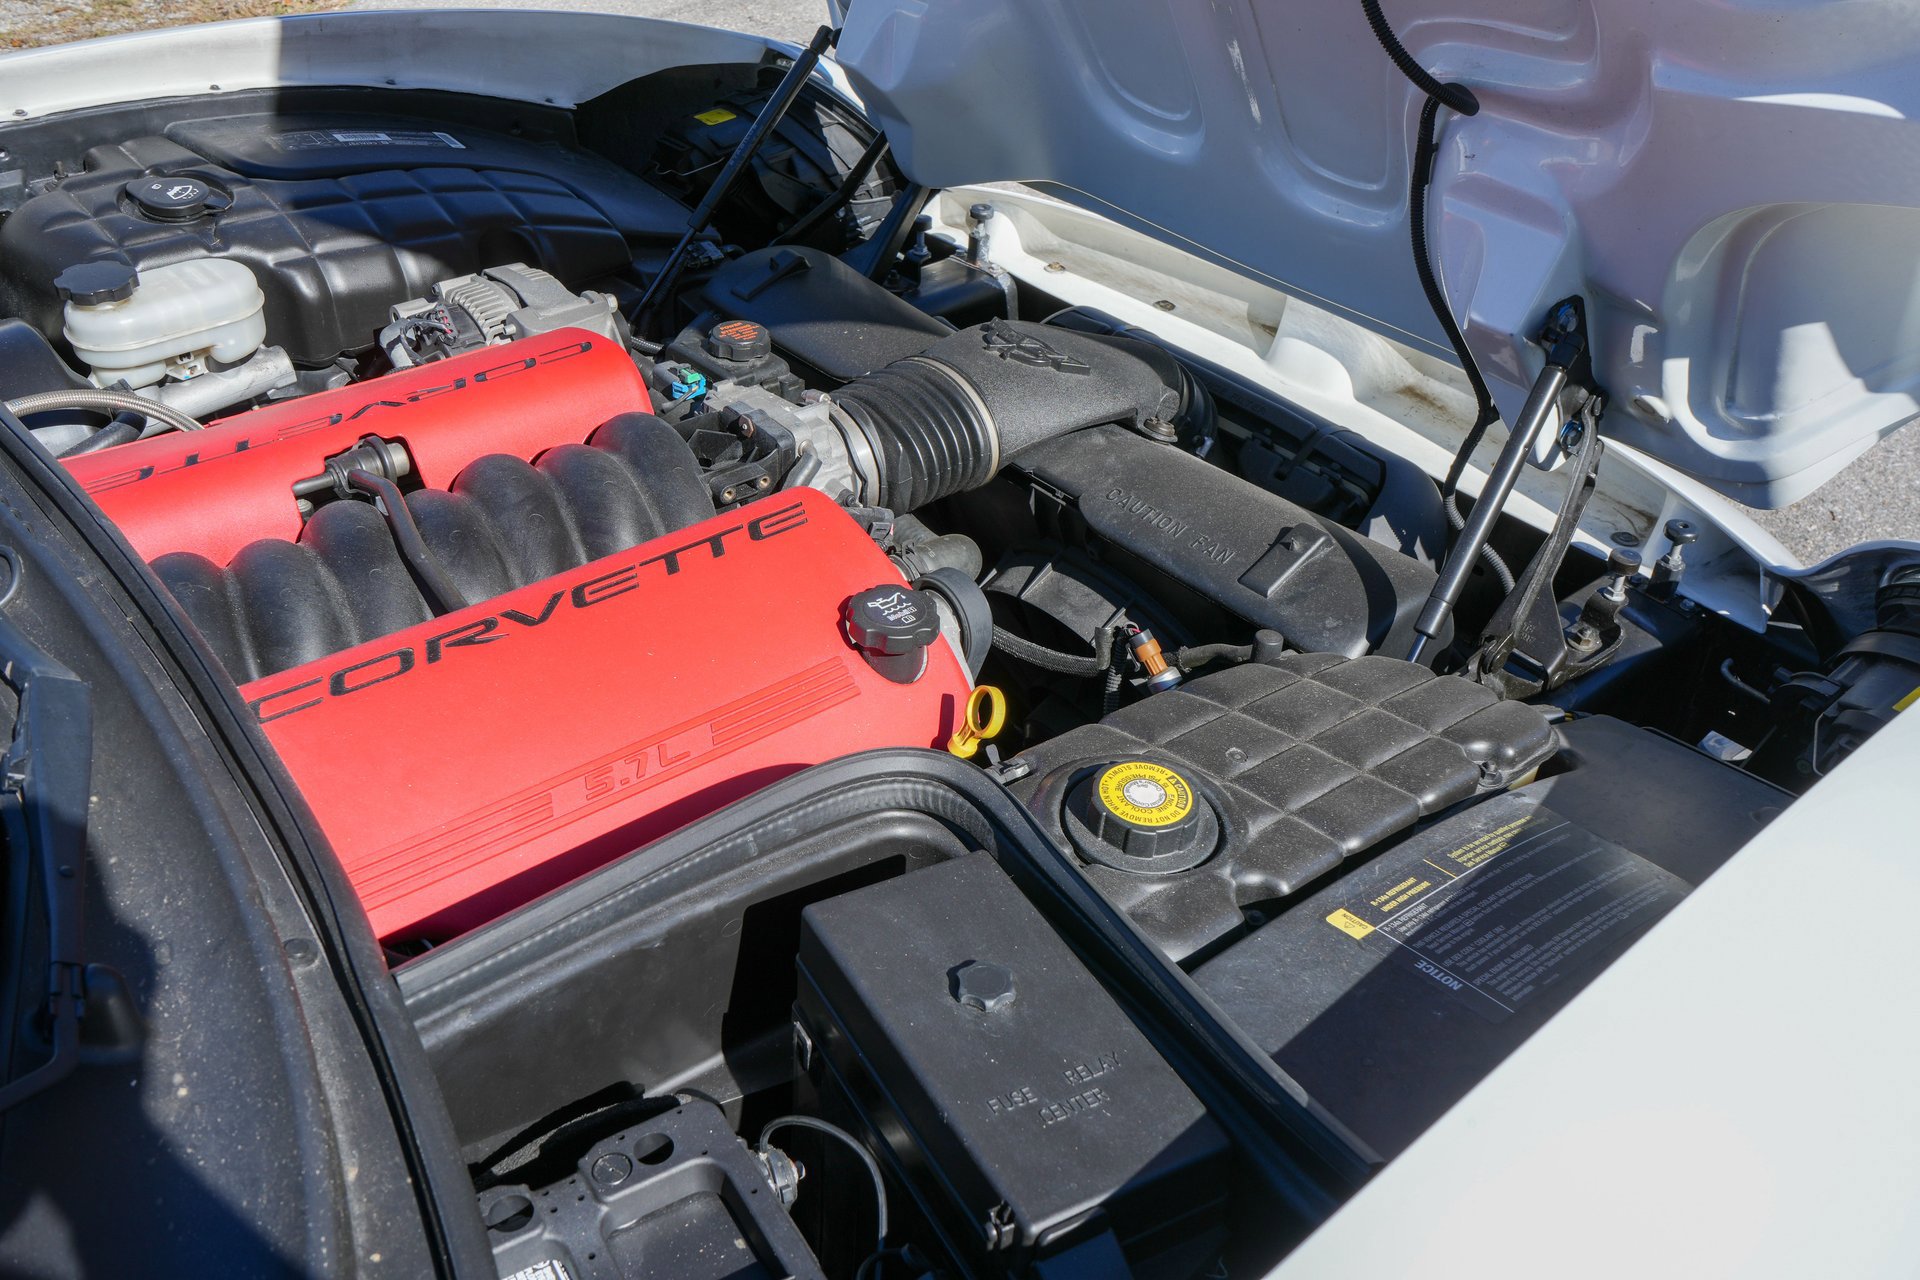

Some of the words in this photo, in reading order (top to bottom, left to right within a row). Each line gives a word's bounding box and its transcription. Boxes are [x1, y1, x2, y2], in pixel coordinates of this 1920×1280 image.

[82, 341, 592, 494] CORVETTE
[1105, 488, 1188, 538] CAUTION
[1190, 533, 1236, 565] FAN
[248, 500, 809, 723] CORVETTE
[585, 743, 691, 801] 5.7L
[1107, 765, 1132, 779] SLOWLY
[1134, 764, 1166, 775] REMOVE
[1115, 774, 1146, 792] PRESSURE
[1104, 795, 1120, 812] WHEN
[1116, 795, 1154, 814] COOLANT
[1156, 793, 1175, 813] ENGINE
[1175, 782, 1187, 809] CAUTION
[1120, 810, 1153, 823] REMOVE
[1155, 815, 1171, 823] NOT
[1170, 810, 1181, 818] DO
[1384, 876, 1418, 896] REFRIGERANT
[1341, 913, 1368, 930] CAUTION
[1414, 960, 1463, 991] NOTICE
[986, 1087, 1038, 1115] FUSE
[1063, 1050, 1122, 1085] RELAY
[1038, 1087, 1110, 1124] CENTER
